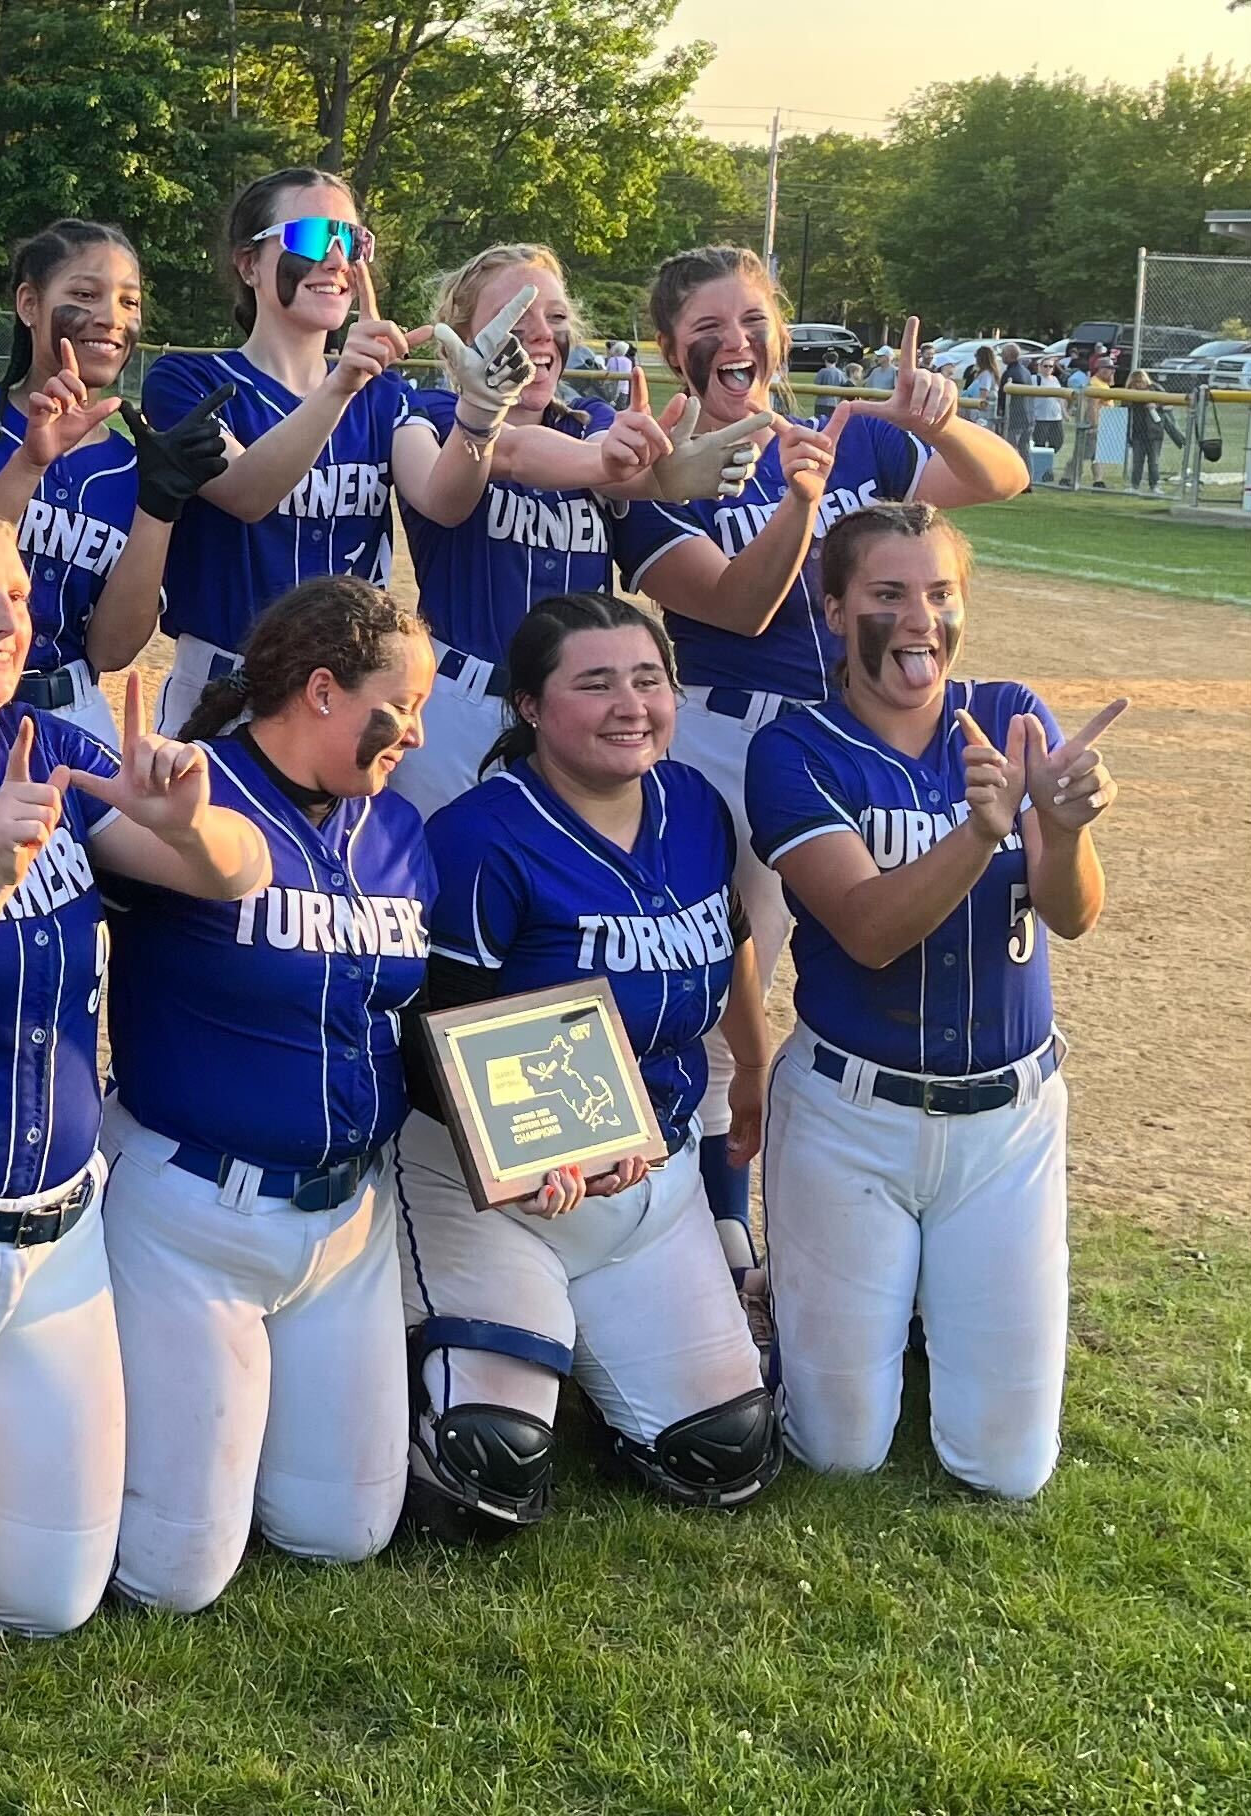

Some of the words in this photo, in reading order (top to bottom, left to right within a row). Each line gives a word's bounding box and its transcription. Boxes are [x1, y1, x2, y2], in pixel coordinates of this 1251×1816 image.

[278, 462, 389, 520] RNERS
[488, 483, 607, 553] URNER
[15, 498, 129, 580] RNER
[577, 884, 735, 973] TURNER
[1008, 883, 1037, 964] 5
[513, 1123, 563, 1145] CHAMPIONS
